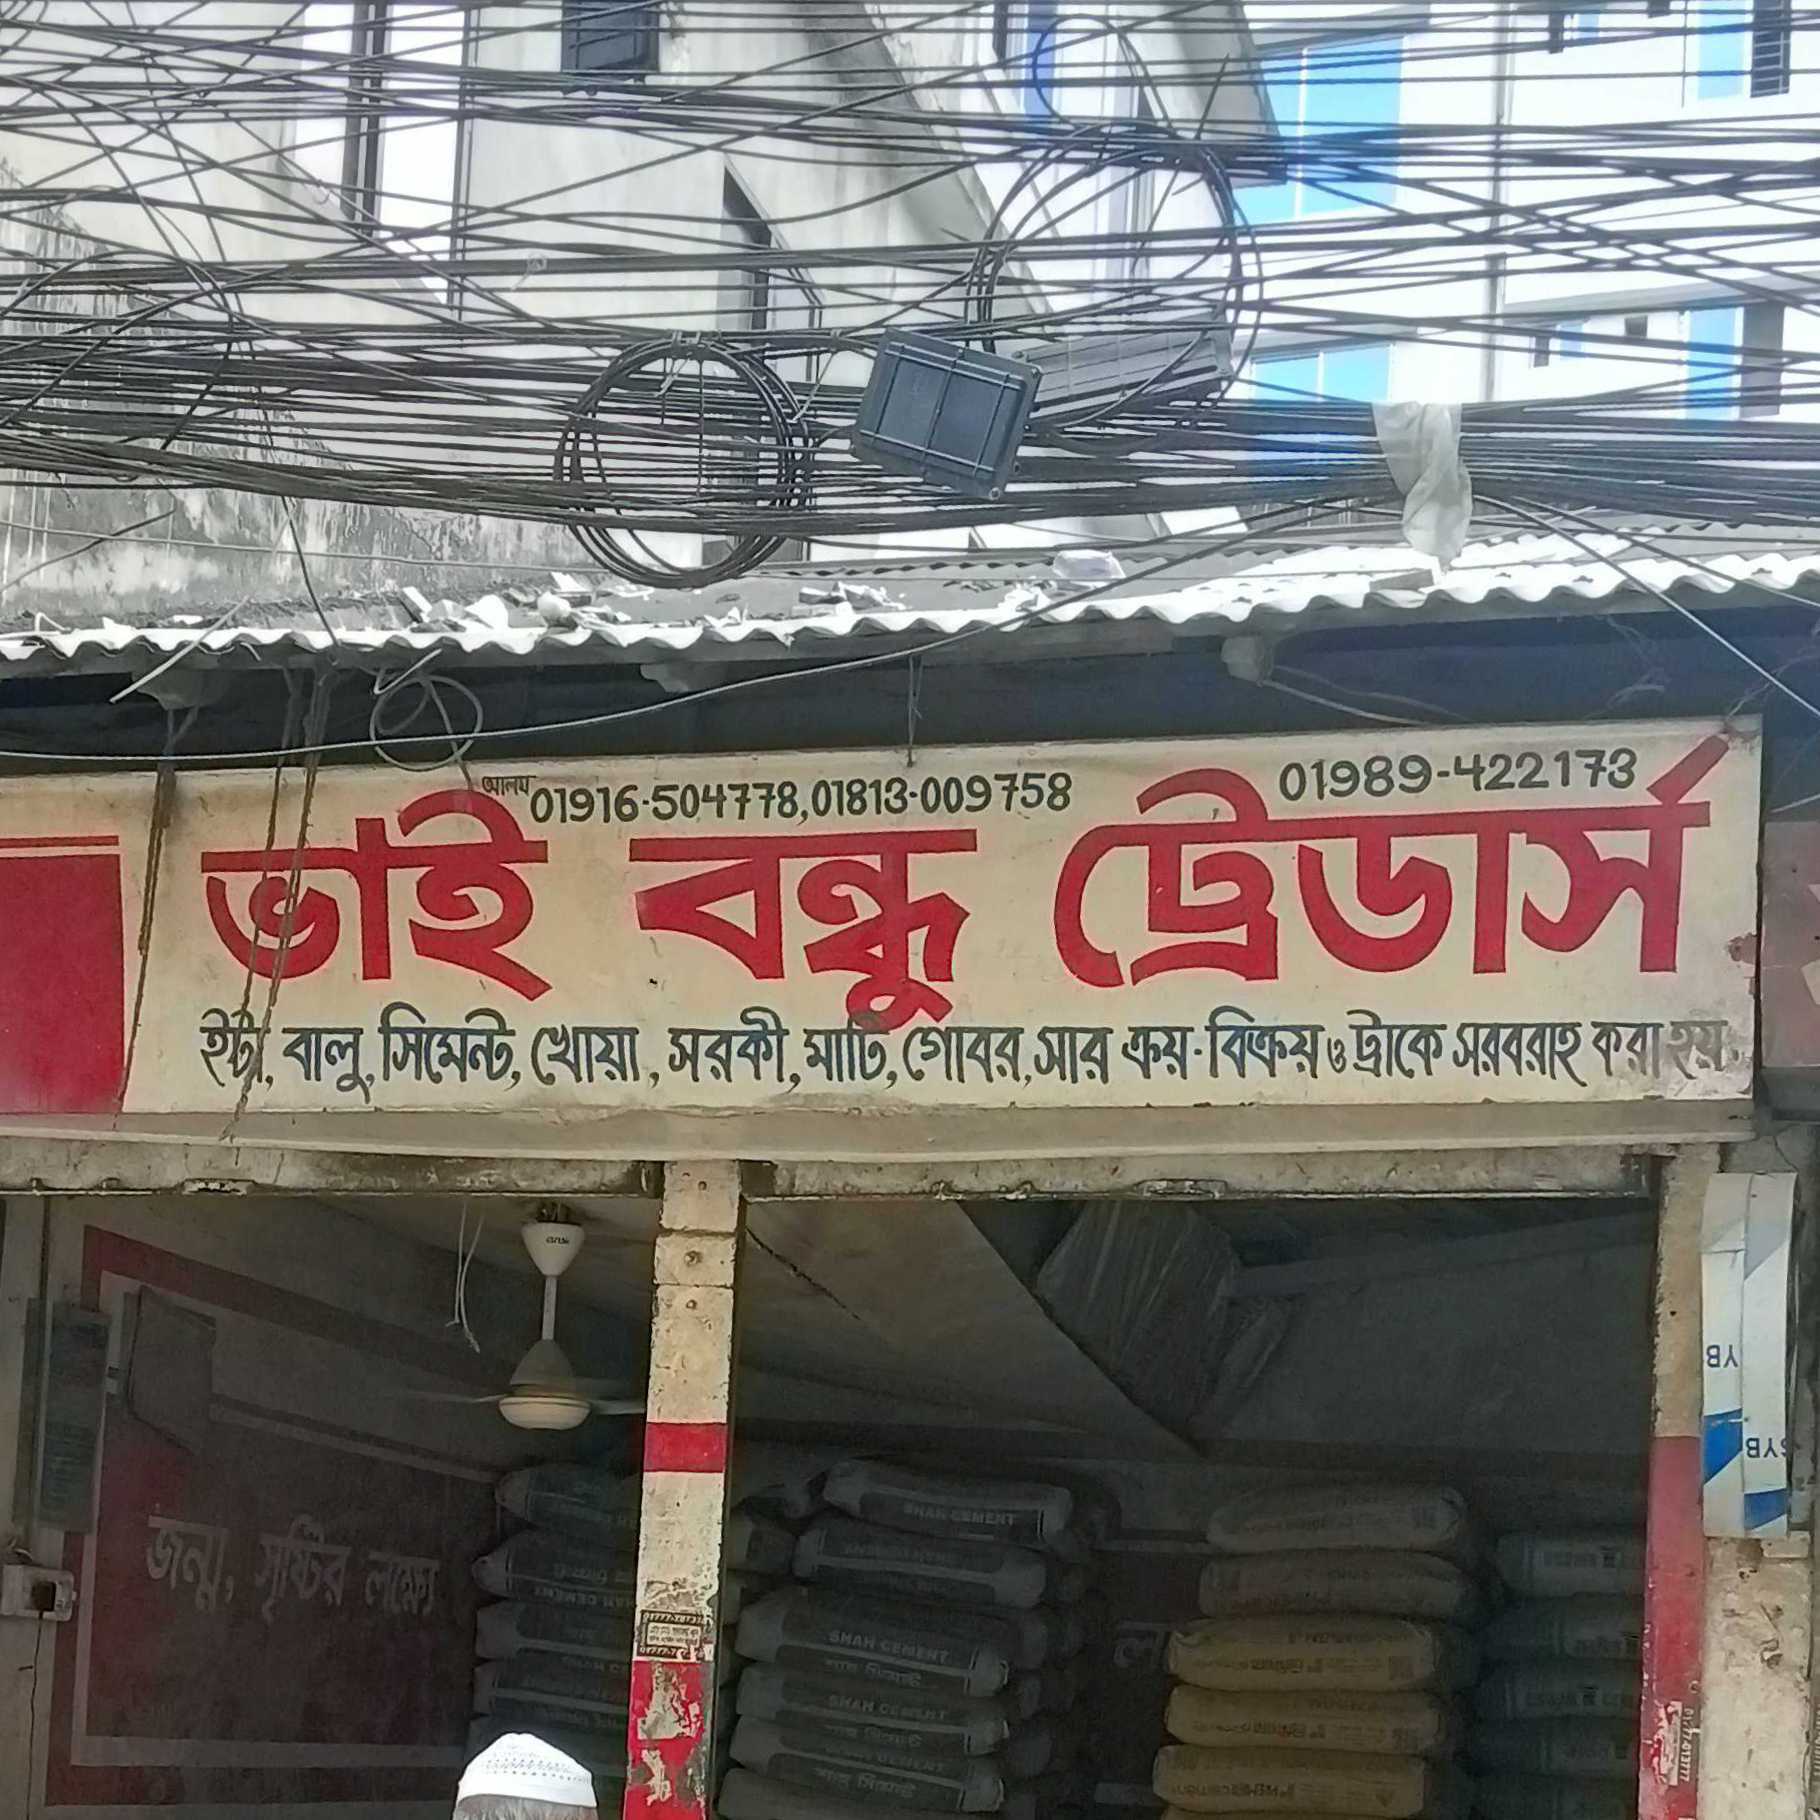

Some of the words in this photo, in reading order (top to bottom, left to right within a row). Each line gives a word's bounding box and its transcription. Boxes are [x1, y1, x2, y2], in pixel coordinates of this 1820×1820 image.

[1279, 748, 1638, 801] 01989-422173
[201, 789, 553, 1001] ভাই
[629, 828, 977, 1031] বন্ধু
[1054, 734, 1729, 986] ট্রেডার্স
[1034, 1026, 1114, 1084] সার
[1327, 1036, 1347, 1074] ও
[1347, 1009, 1447, 1079] ট্রাকে
[1453, 1022, 1588, 1087] সরবরাহ
[1591, 1021, 1665, 1079] করা
[880, 1638, 950, 1662] CEMENT
